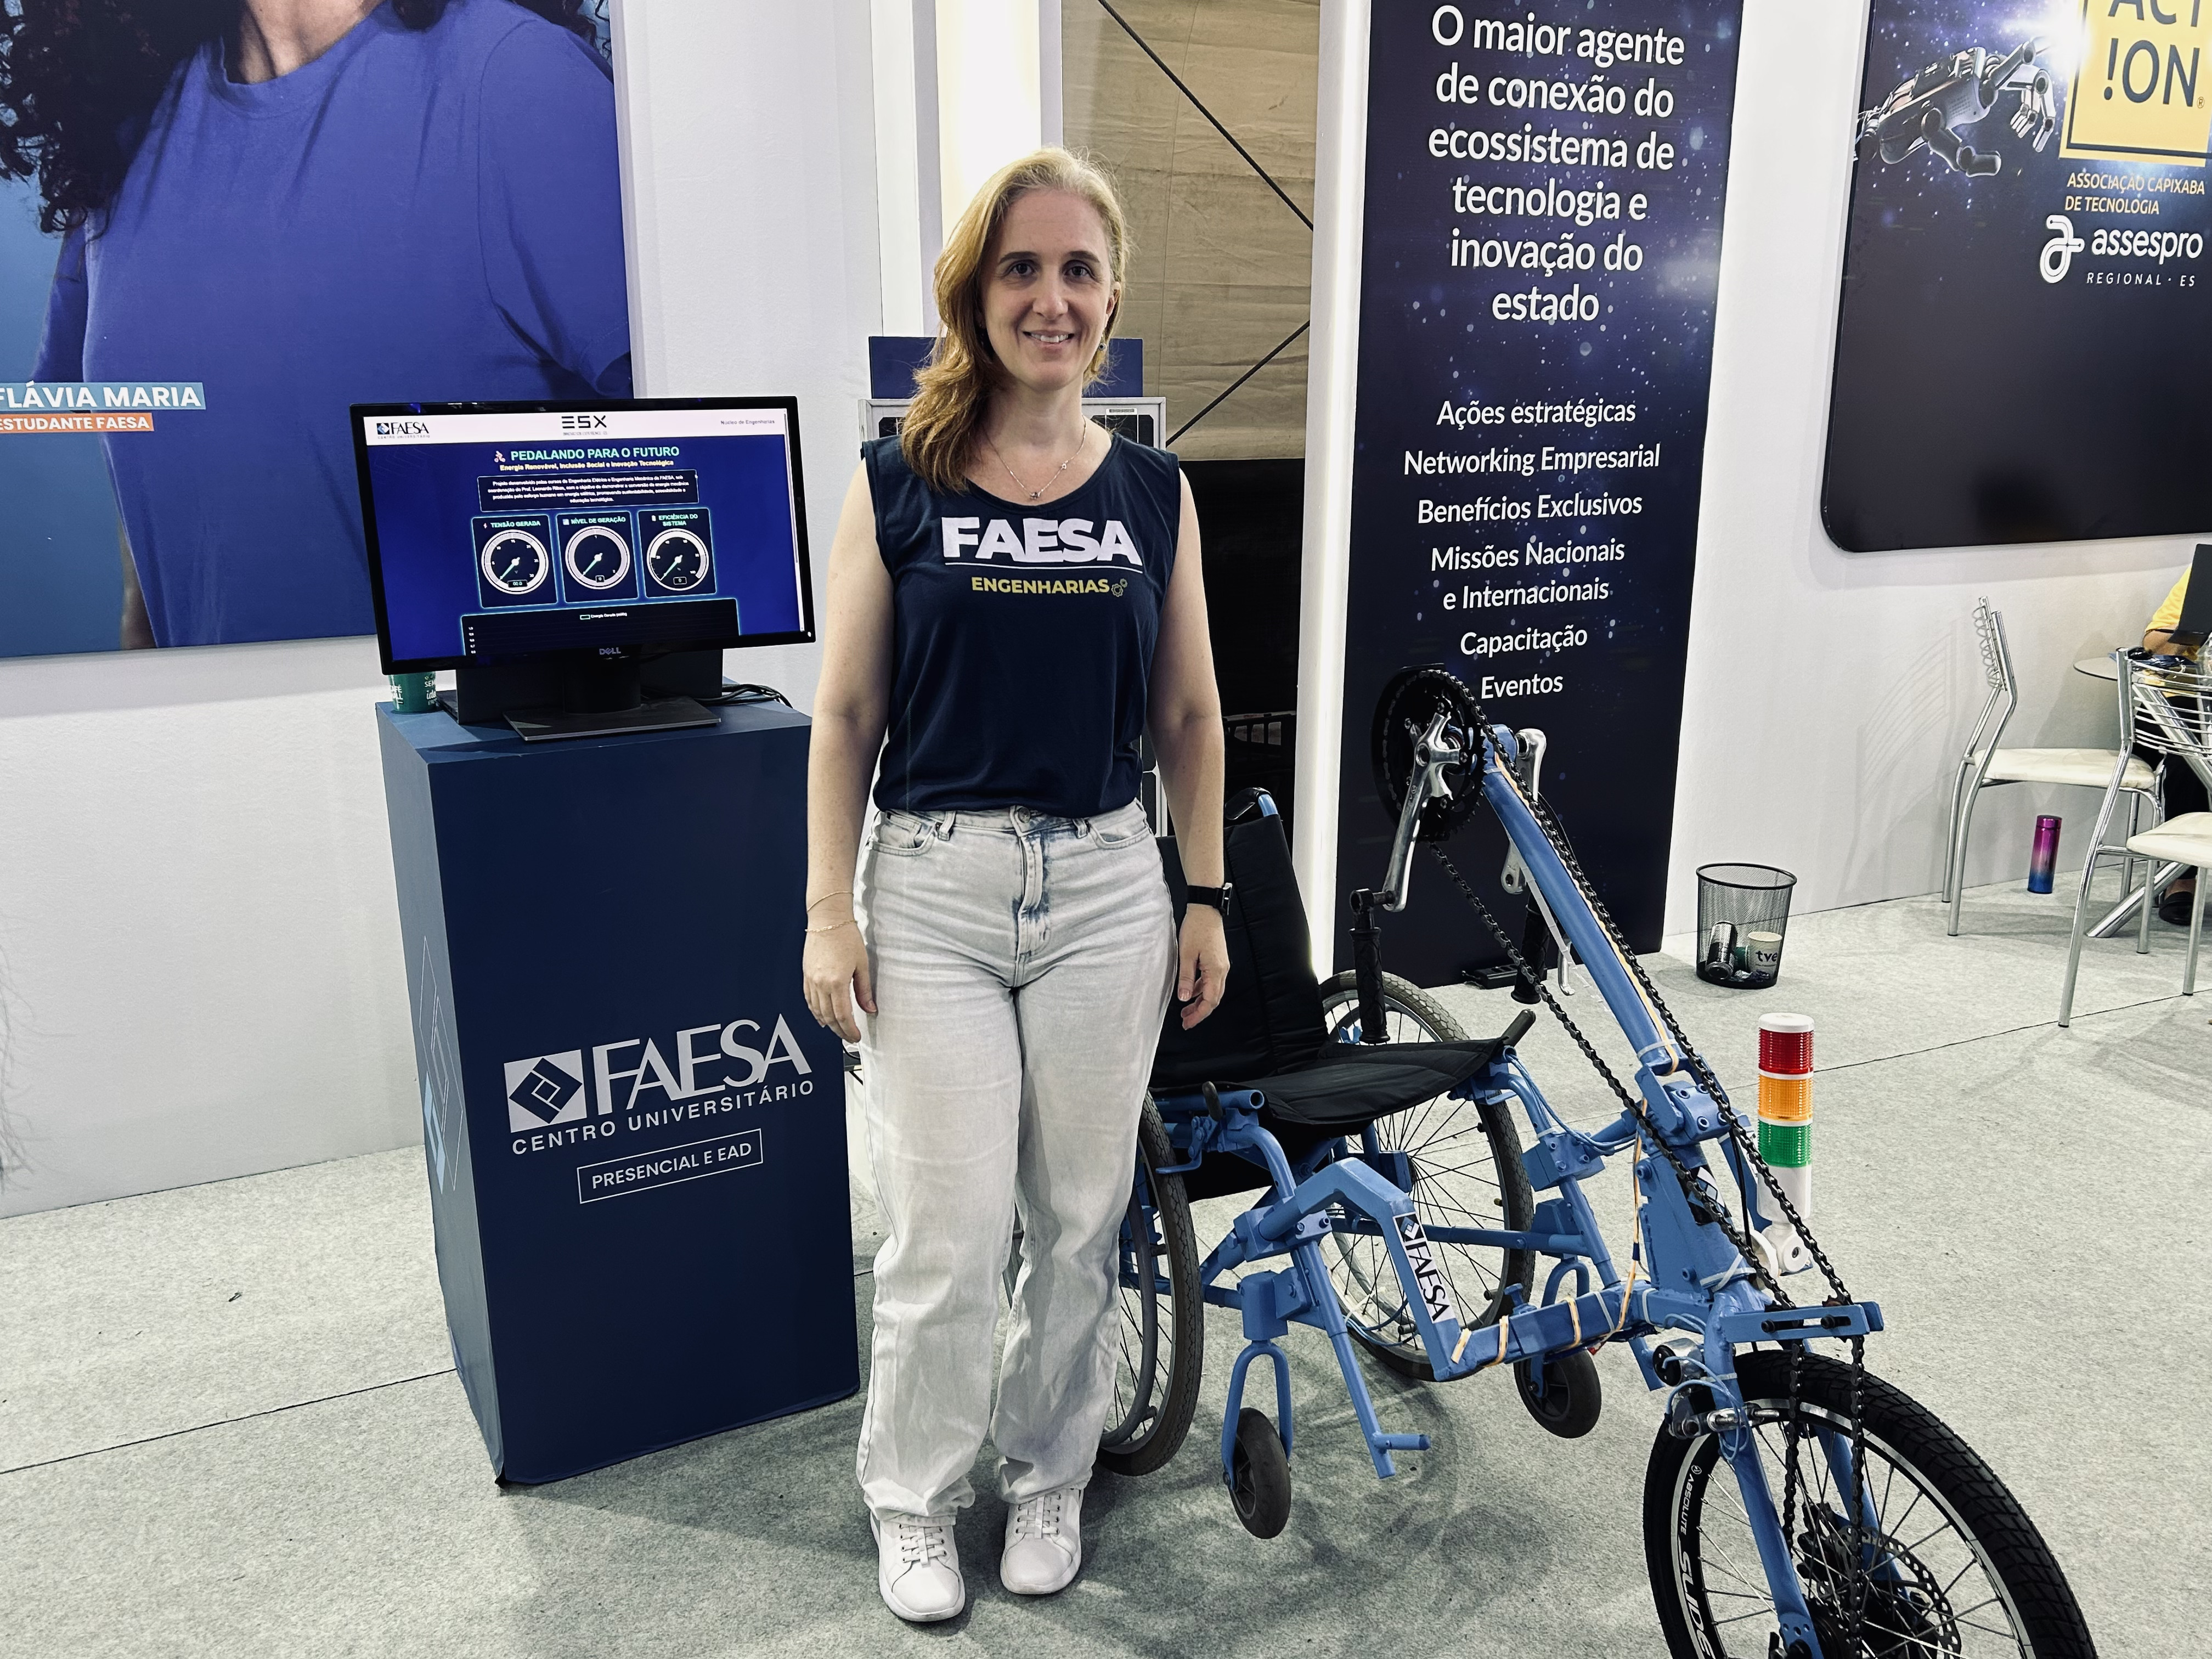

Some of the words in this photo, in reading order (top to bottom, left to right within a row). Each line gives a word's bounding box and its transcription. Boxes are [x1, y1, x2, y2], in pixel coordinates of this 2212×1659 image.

[1432, 5, 1464, 46] O
[1474, 12, 1571, 55] maior
[1577, 27, 1685, 67] agente
[1436, 62, 1479, 104] de
[1488, 75, 1626, 115] conexão
[1634, 78, 1674, 117] do
[1429, 123, 1628, 168] ecossistema
[1636, 132, 1674, 170] de
[2067, 171, 2145, 195] ASSOCIAÇÃO
[2147, 177, 2205, 195] CAPIXABA
[1453, 178, 1621, 226] tecnologia
[1629, 193, 1647, 220] e
[2064, 195, 2082, 211] DE
[2084, 196, 2160, 215] TECNOLOGIA
[1451, 228, 1596, 276] inovação
[1604, 234, 1643, 271] do
[2091, 229, 2203, 264] assespro
[2086, 272, 2162, 285] REGIONAL
[2180, 275, 2196, 287] ES
[1492, 284, 1600, 321] estado
[103, 387, 201, 407] MARIA
[1436, 400, 1505, 430] Ações
[1511, 398, 1636, 427] estratégicas
[96, 417, 149, 428] FAESA
[391, 422, 429, 434] FAESA
[511, 449, 585, 461] PEDALANDO
[588, 448, 619, 458] PARA
[622, 448, 630, 458] O
[633, 447, 679, 457] FUTURO
[1404, 448, 1536, 476] Networking
[1541, 444, 1661, 475] Empresarial
[1418, 496, 1532, 523] Benefícios
[1537, 492, 1643, 518] Exclusivos
[941, 517, 1143, 566] FAESA
[1431, 545, 1519, 572] Missões
[1525, 538, 1625, 566] Nacionais
[971, 577, 1110, 594] ENGENHARIAS
[1443, 591, 1456, 610] e
[1463, 578, 1609, 610] Internacionais
[1460, 624, 1588, 658] Capacitação
[1481, 673, 1564, 699] Eventos
[592, 1013, 812, 1116] FAESA
[512, 1121, 616, 1155] CENTRO
[628, 1081, 813, 1131] UNIVERSITÁRIO
[592, 1154, 699, 1189] PRESENCIAL
[704, 1151, 712, 1164] E
[718, 1143, 752, 1161] EAD
[1405, 1241, 1449, 1321] FAESA
[1680, 1474, 1694, 1535] ABSOLUTE
